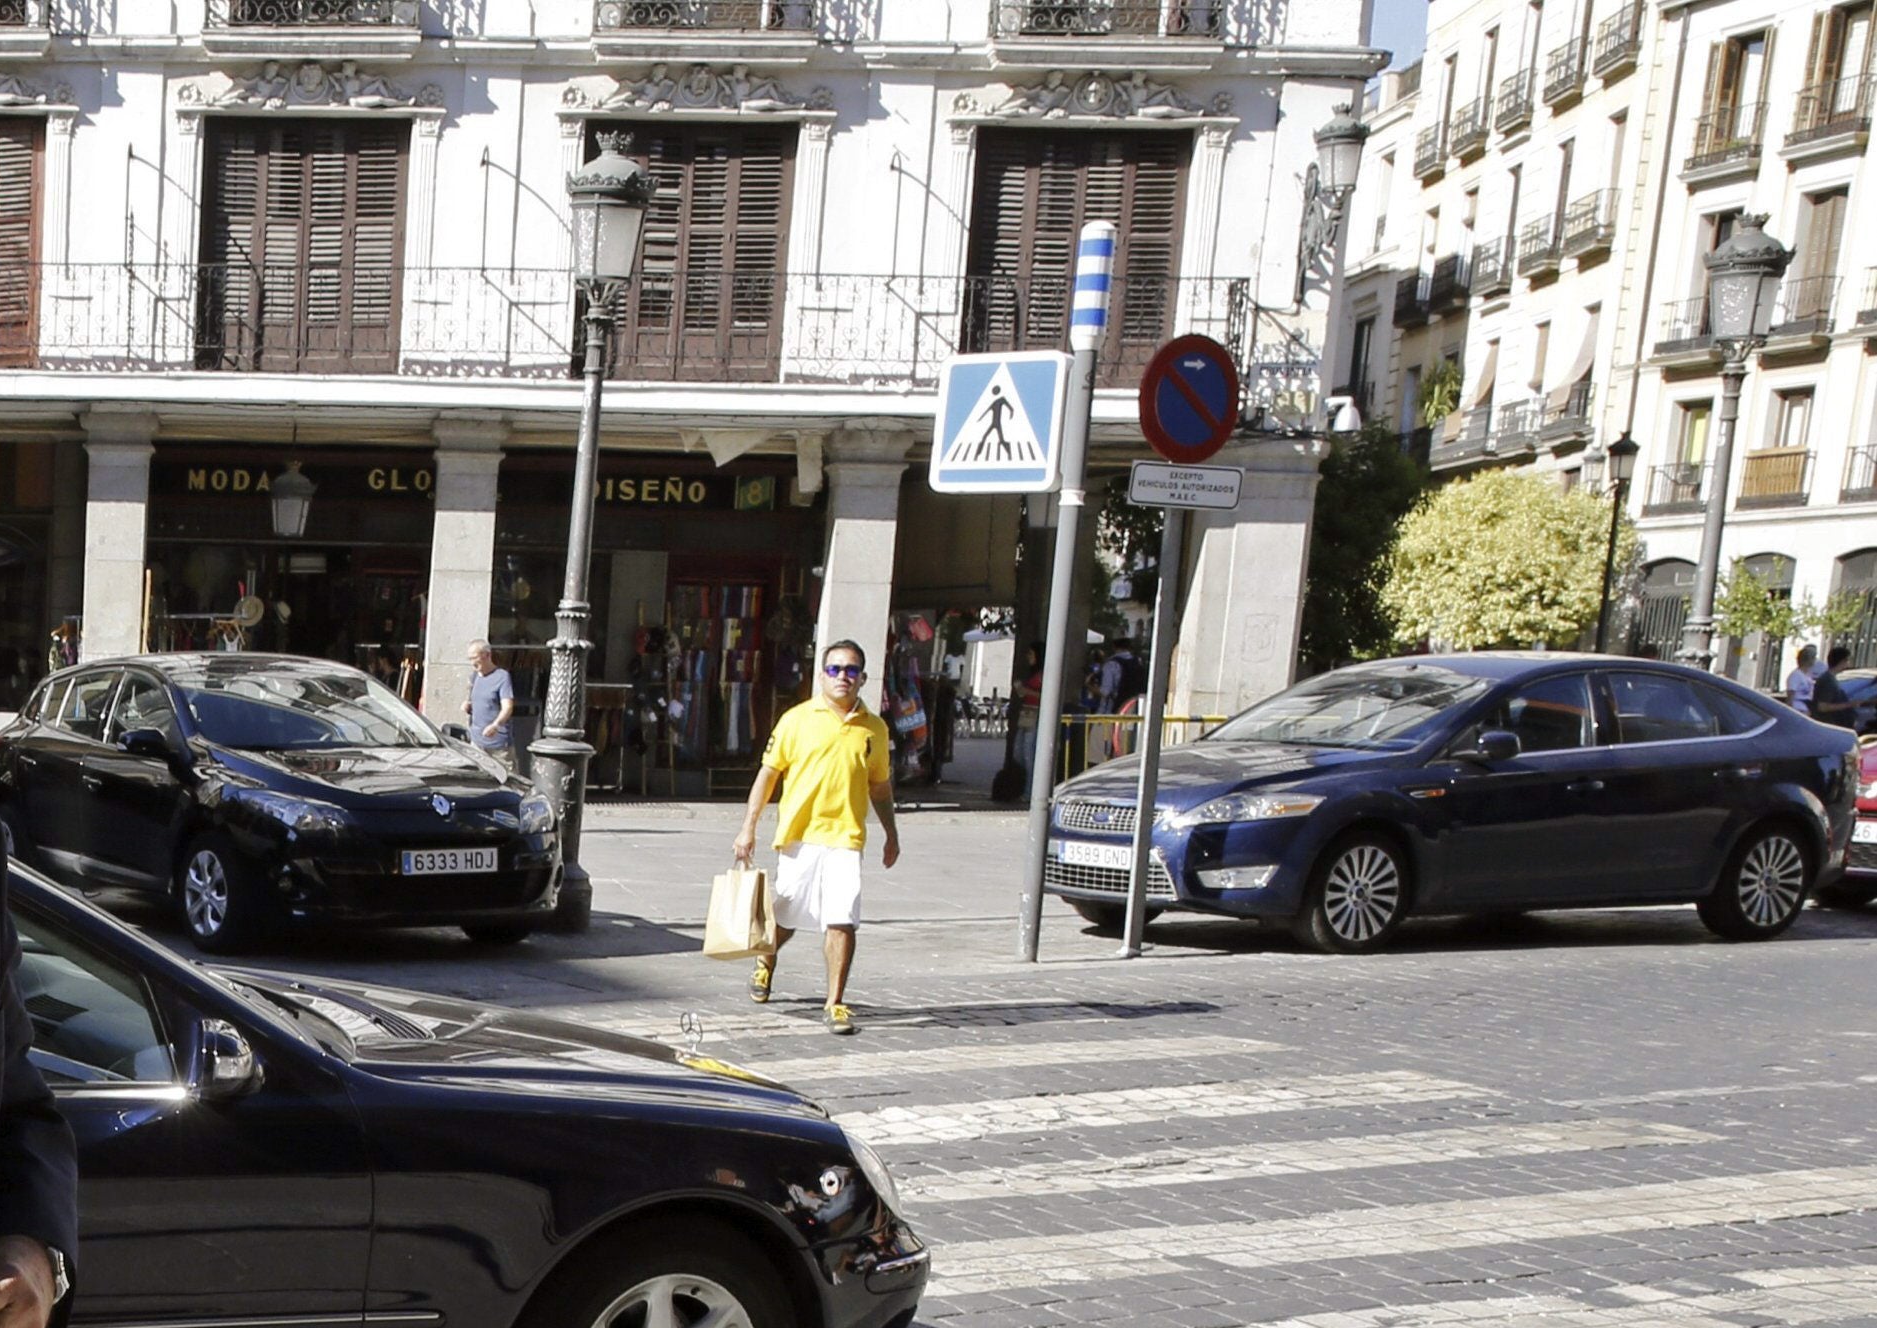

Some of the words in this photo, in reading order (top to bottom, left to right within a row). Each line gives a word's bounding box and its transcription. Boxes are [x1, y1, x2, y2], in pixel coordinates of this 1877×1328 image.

[367, 469, 432, 491] GLO
[1169, 471, 1204, 481] EXCEPTO
[1181, 482, 1235, 494] AUTORIZADOS
[414, 853, 458, 871] 6333
[464, 851, 494, 869] HDJ
[1069, 845, 1100, 863] 3589
